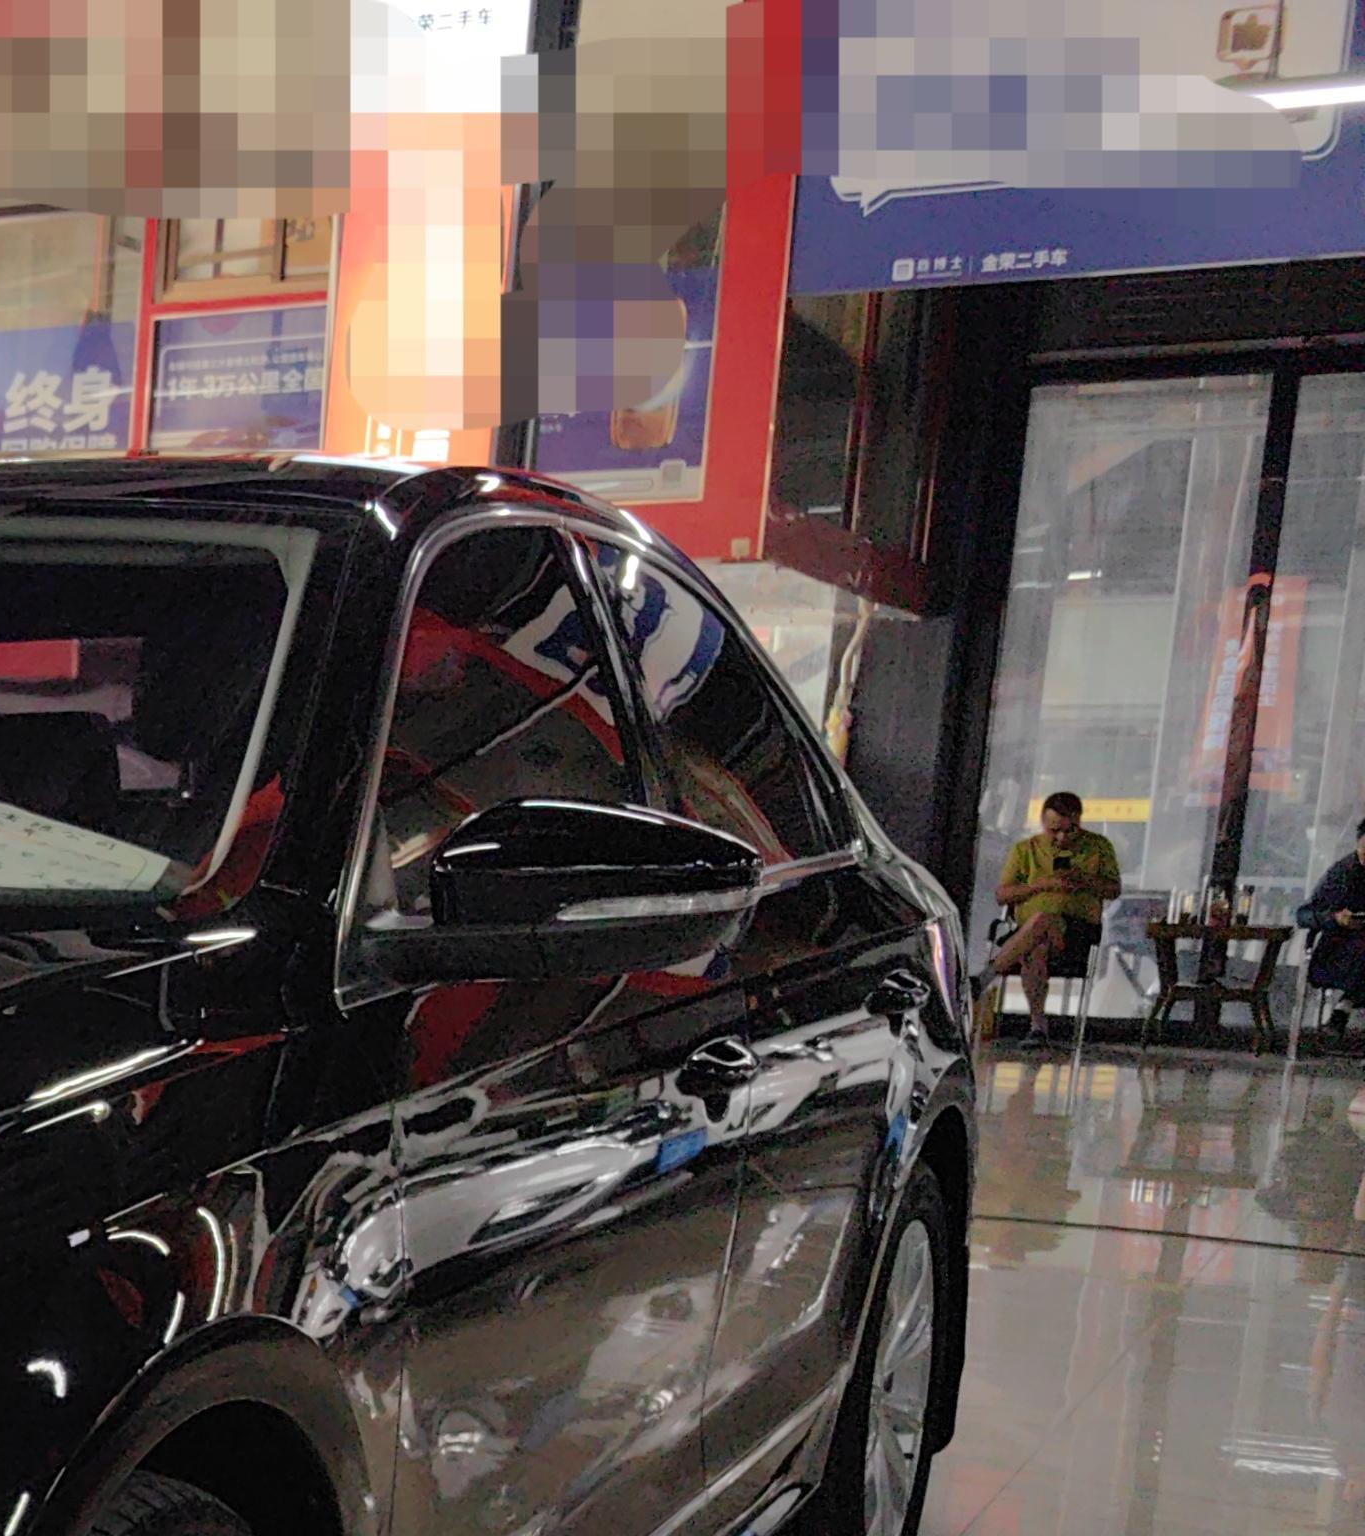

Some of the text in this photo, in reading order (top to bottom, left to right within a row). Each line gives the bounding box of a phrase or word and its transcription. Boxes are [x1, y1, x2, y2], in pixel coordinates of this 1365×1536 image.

[980, 248, 1068, 273] 金荣二手车
[3, 365, 118, 433] 终身
